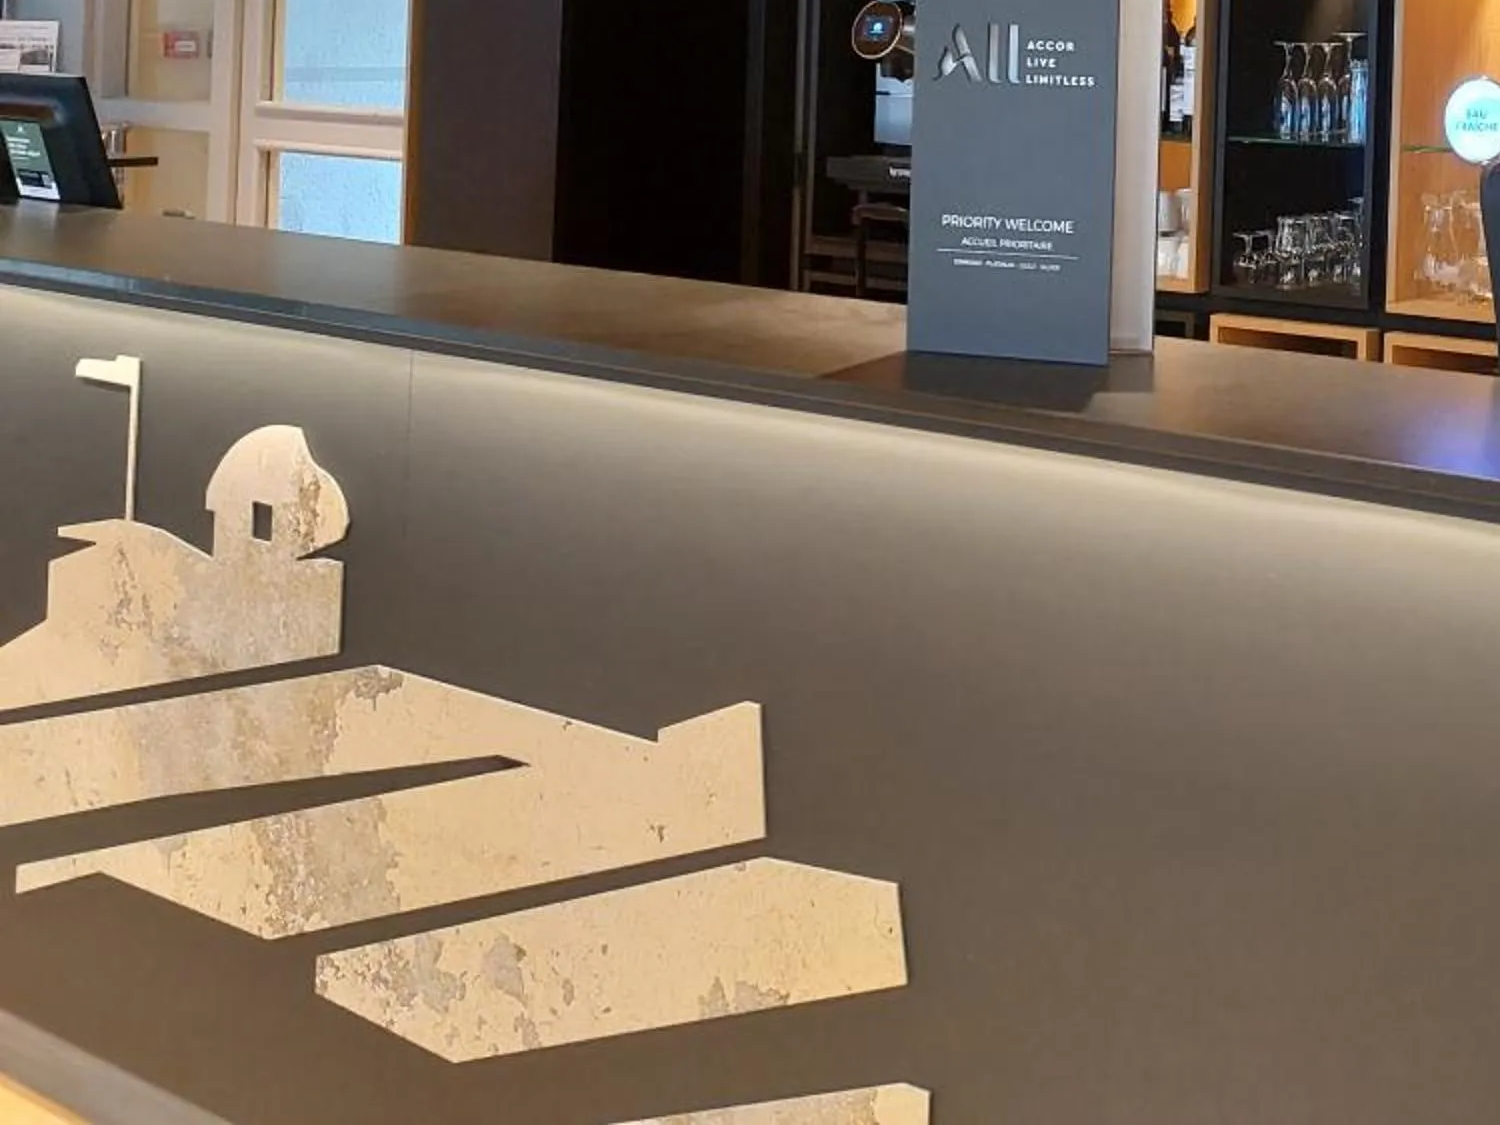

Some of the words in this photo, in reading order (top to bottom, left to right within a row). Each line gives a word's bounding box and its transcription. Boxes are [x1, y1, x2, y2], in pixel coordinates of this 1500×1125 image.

[1026, 39, 1075, 52] ACCOR
[1026, 57, 1056, 68] LIVE
[1025, 74, 1096, 87] LIMITLESS
[942, 214, 1002, 230] PRIORITY
[1005, 218, 1075, 234] WELCOME
